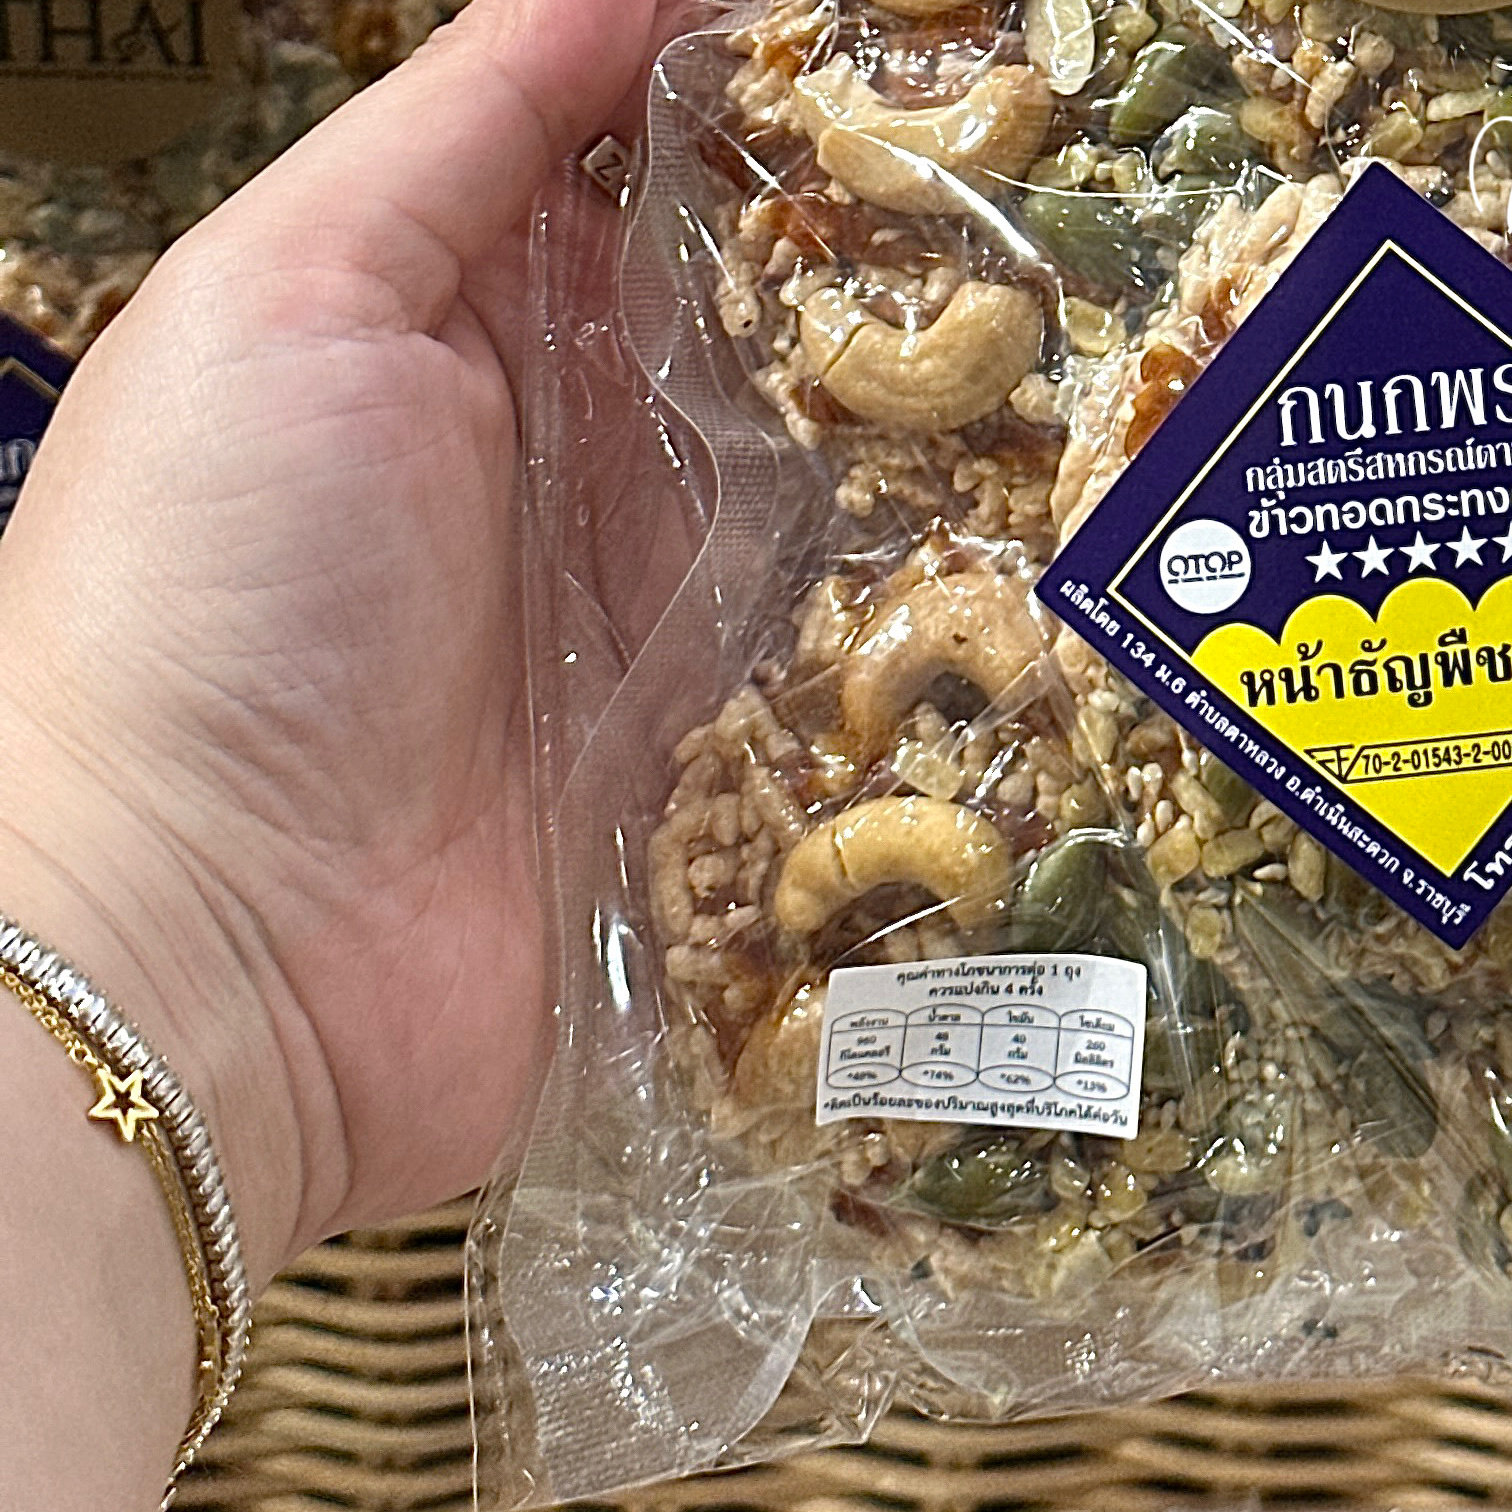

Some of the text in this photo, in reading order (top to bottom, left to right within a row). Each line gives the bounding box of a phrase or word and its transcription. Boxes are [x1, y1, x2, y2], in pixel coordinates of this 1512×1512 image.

[1166, 550, 1244, 578] OTOP
[1060, 580, 1121, 637] ผลิตโดย
[1121, 633, 1156, 668] 134
[1403, 868, 1472, 925] จ.ราชบุรี
[1051, 963, 1059, 977] 1
[1004, 984, 1014, 995] 4
